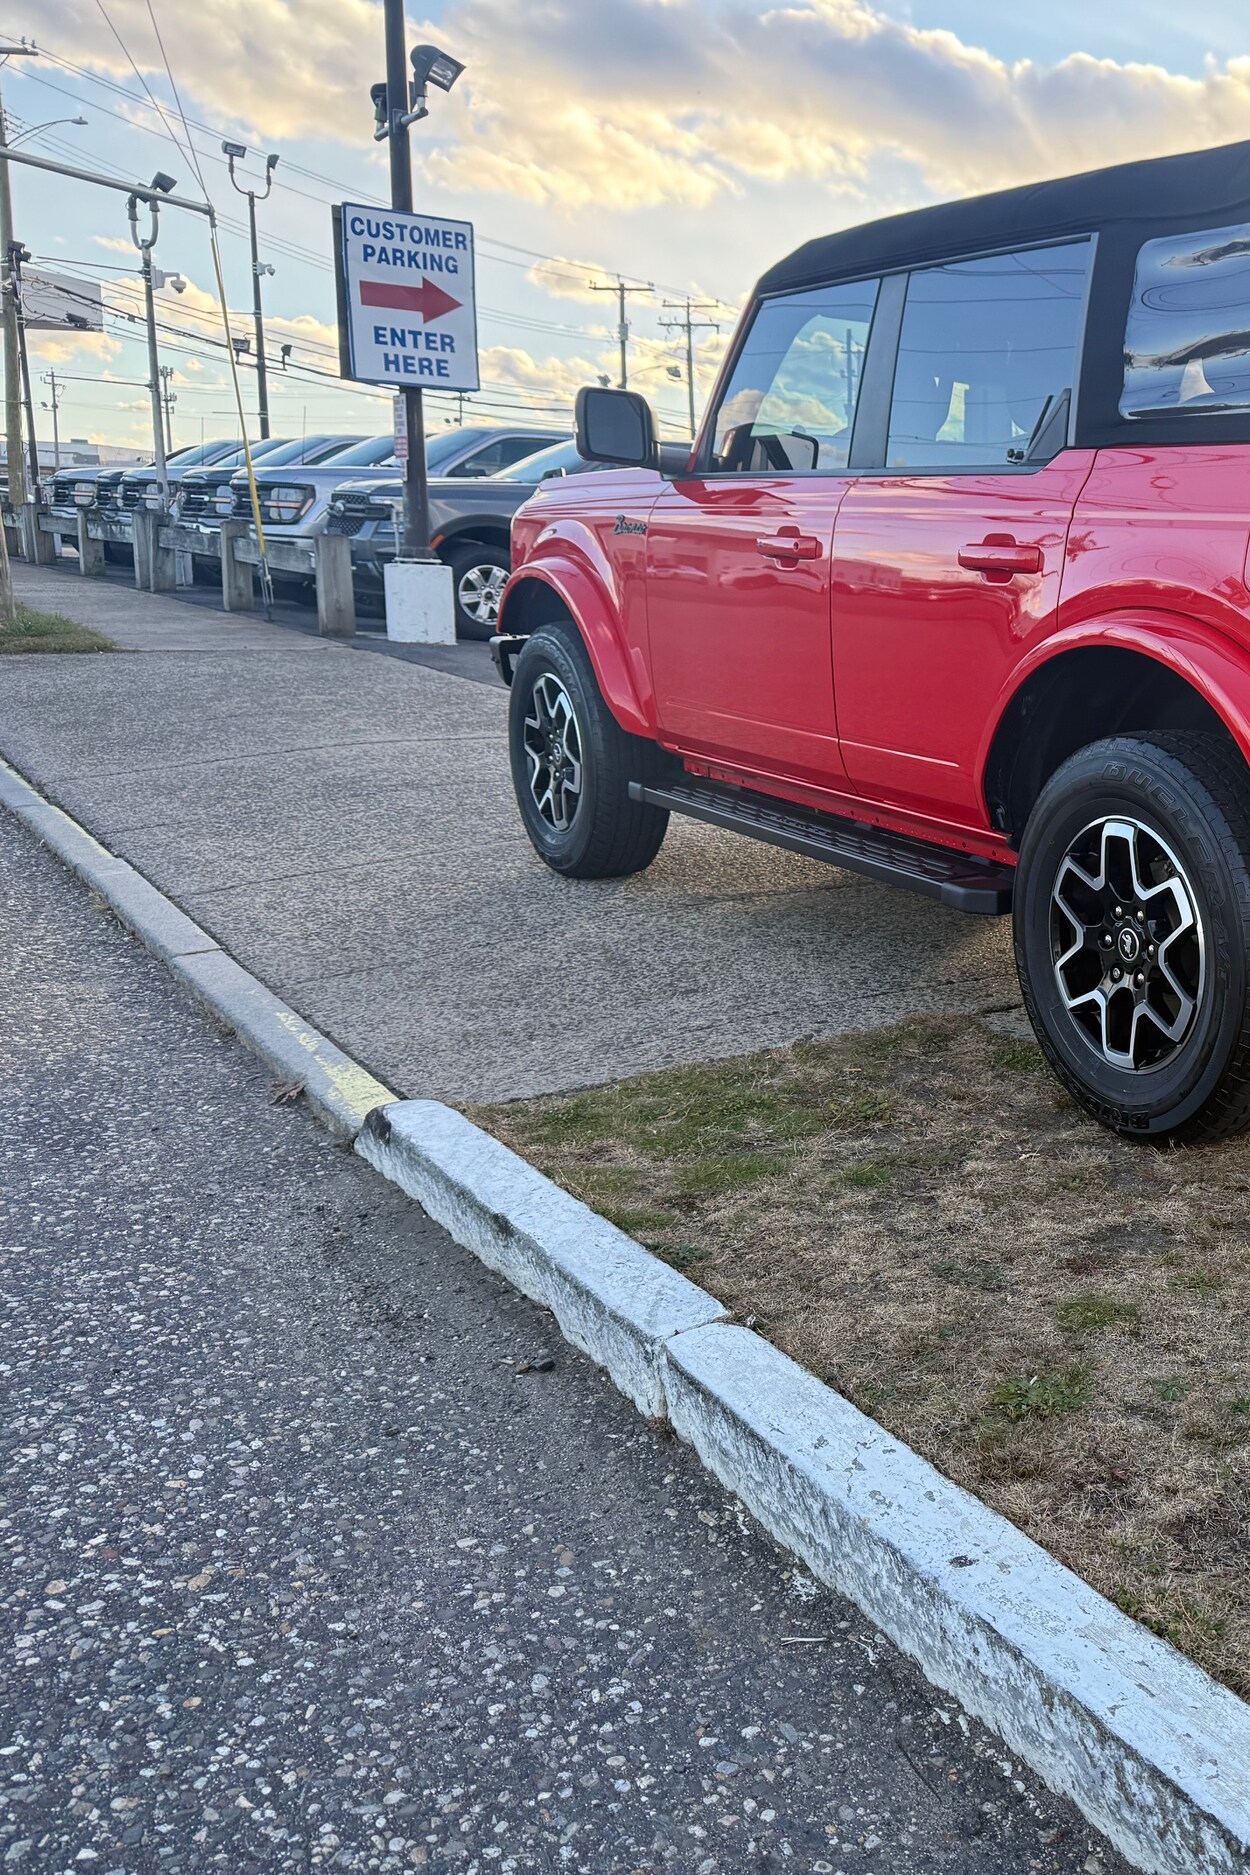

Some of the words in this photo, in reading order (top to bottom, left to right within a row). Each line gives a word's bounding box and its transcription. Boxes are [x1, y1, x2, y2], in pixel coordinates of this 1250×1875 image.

[350, 216, 468, 251] CUSTOMER
[362, 243, 459, 274] PARKING
[373, 325, 456, 353] ENTER
[383, 352, 450, 378] HERE
